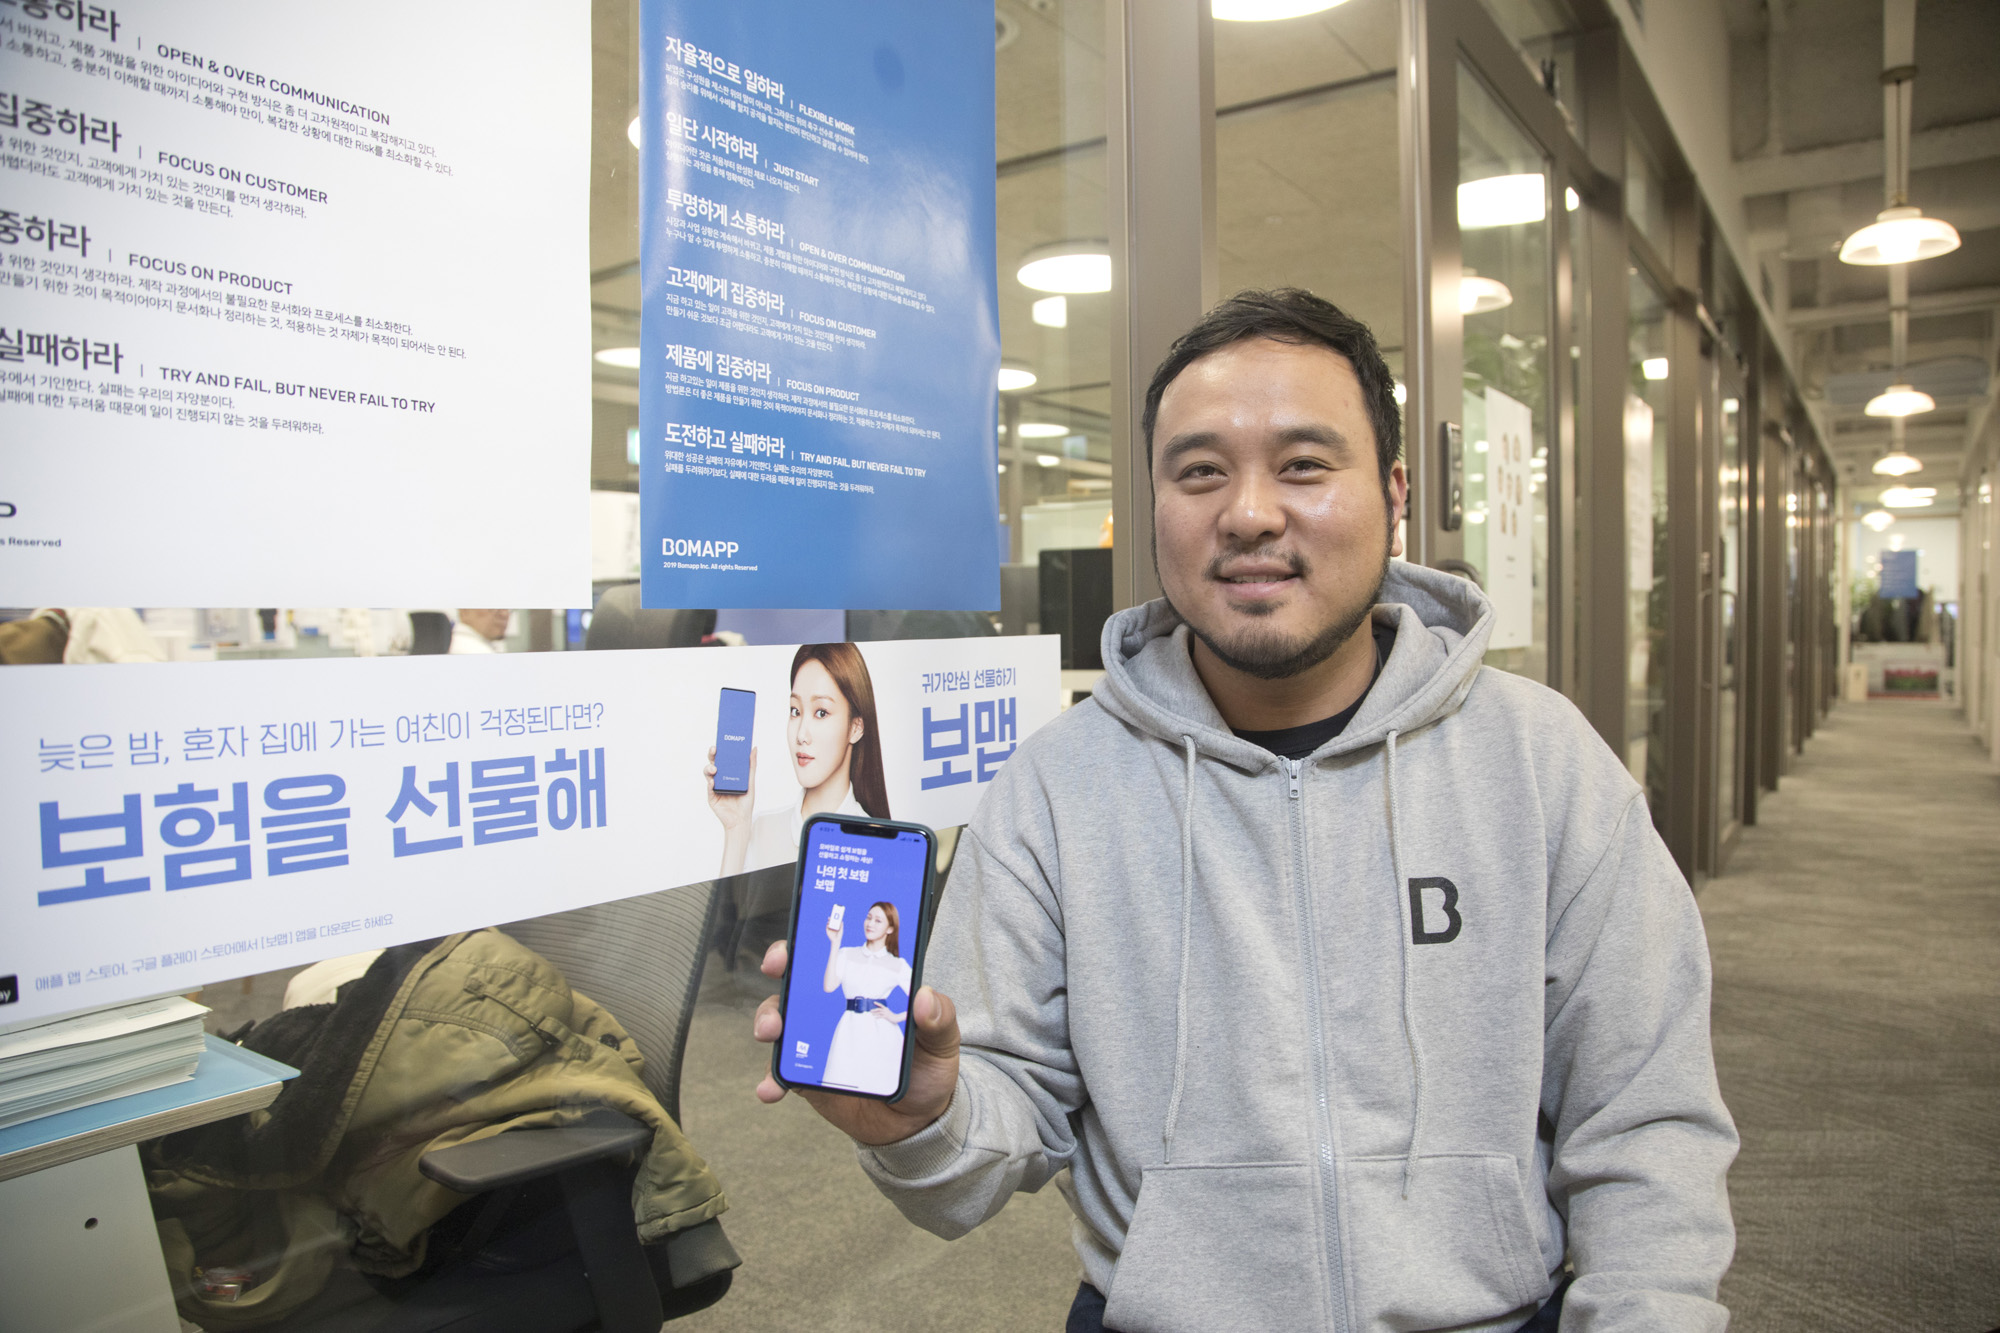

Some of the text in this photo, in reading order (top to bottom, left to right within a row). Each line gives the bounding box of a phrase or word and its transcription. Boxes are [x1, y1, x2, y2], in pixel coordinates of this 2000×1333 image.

[158, 45, 389, 124] OPEN & OVER COMMUNICATION
[665, 37, 785, 105] 자율적으로 일하라
[666, 112, 758, 164] 일단 시작하라
[799, 104, 855, 135] FLEXIBLE WORK
[9, 137, 306, 218] 위한 것인지, 고객에게 가치 있는 것인지를 먼저 생각하라.
[159, 152, 327, 203] FOCUS ON CUSTOMER
[773, 162, 819, 187] JUST START
[665, 189, 785, 244] 투명하게 소통하라
[129, 254, 292, 294] FOCUS ON PRODUCT
[799, 242, 905, 282] OPEN & OVER COMMUNICATION
[9, 255, 412, 335] 위한 것인지 생각하라. 제작 과정에서의 불필요한 문서화와 프로세스를 최소화한다.
[666, 267, 785, 316] 고객에게 집중하라
[43, 279, 68, 293] 위한
[74, 284, 96, 299] 것이
[102, 289, 172, 311] 목적이어야지
[176, 301, 221, 319] 문서화나
[224, 309, 266, 326] 정리하는
[270, 317, 282, 329] 것,
[286, 320, 326, 336] 적용하는
[329, 327, 338, 338] 것
[341, 329, 369, 343] 자체가
[372, 334, 398, 348] 목적이
[401, 339, 436, 354] 되어서는
[438, 346, 446, 356] 안
[448, 347, 466, 358] 된다.
[799, 311, 876, 338] FOCUS ON CUSTOMER
[665, 344, 771, 384] 제품에 집중하라
[41, 376, 234, 408] 기인한다. 실패는 우리의 자양분이다.
[160, 367, 435, 412] TRY AND FAIL, BUT NEVER FAIL TO TRY
[786, 379, 860, 401] FOCUS ON PRODUCT
[38, 394, 324, 434] 대한 두려움 때문에 일이 진행되지 않는 것을 두려워하라.
[664, 423, 785, 458] 도전하고 실패하라
[800, 452, 926, 477] TRY AND FAIL, BUT NEVER FAIL TO TRY
[8, 538, 61, 547] Reserved
[662, 538, 739, 558] BOMAPP
[922, 668, 1016, 693] 귀가안심 선물하기
[39, 703, 604, 772] 늦은 밤, 혼자 집에 가는 여친이 걱정된다면?
[921, 697, 1017, 791] 보맵
[37, 747, 606, 906] 보험을 선물해
[814, 879, 835, 892] 보맵
[817, 865, 869, 883] 나의 첫 보험
[1408, 877, 1462, 945] B
[35, 914, 393, 990] 애플 앱 스토어, 구글 플레이 스토어에서 [보맵] 앱을 다운로드 하세요
